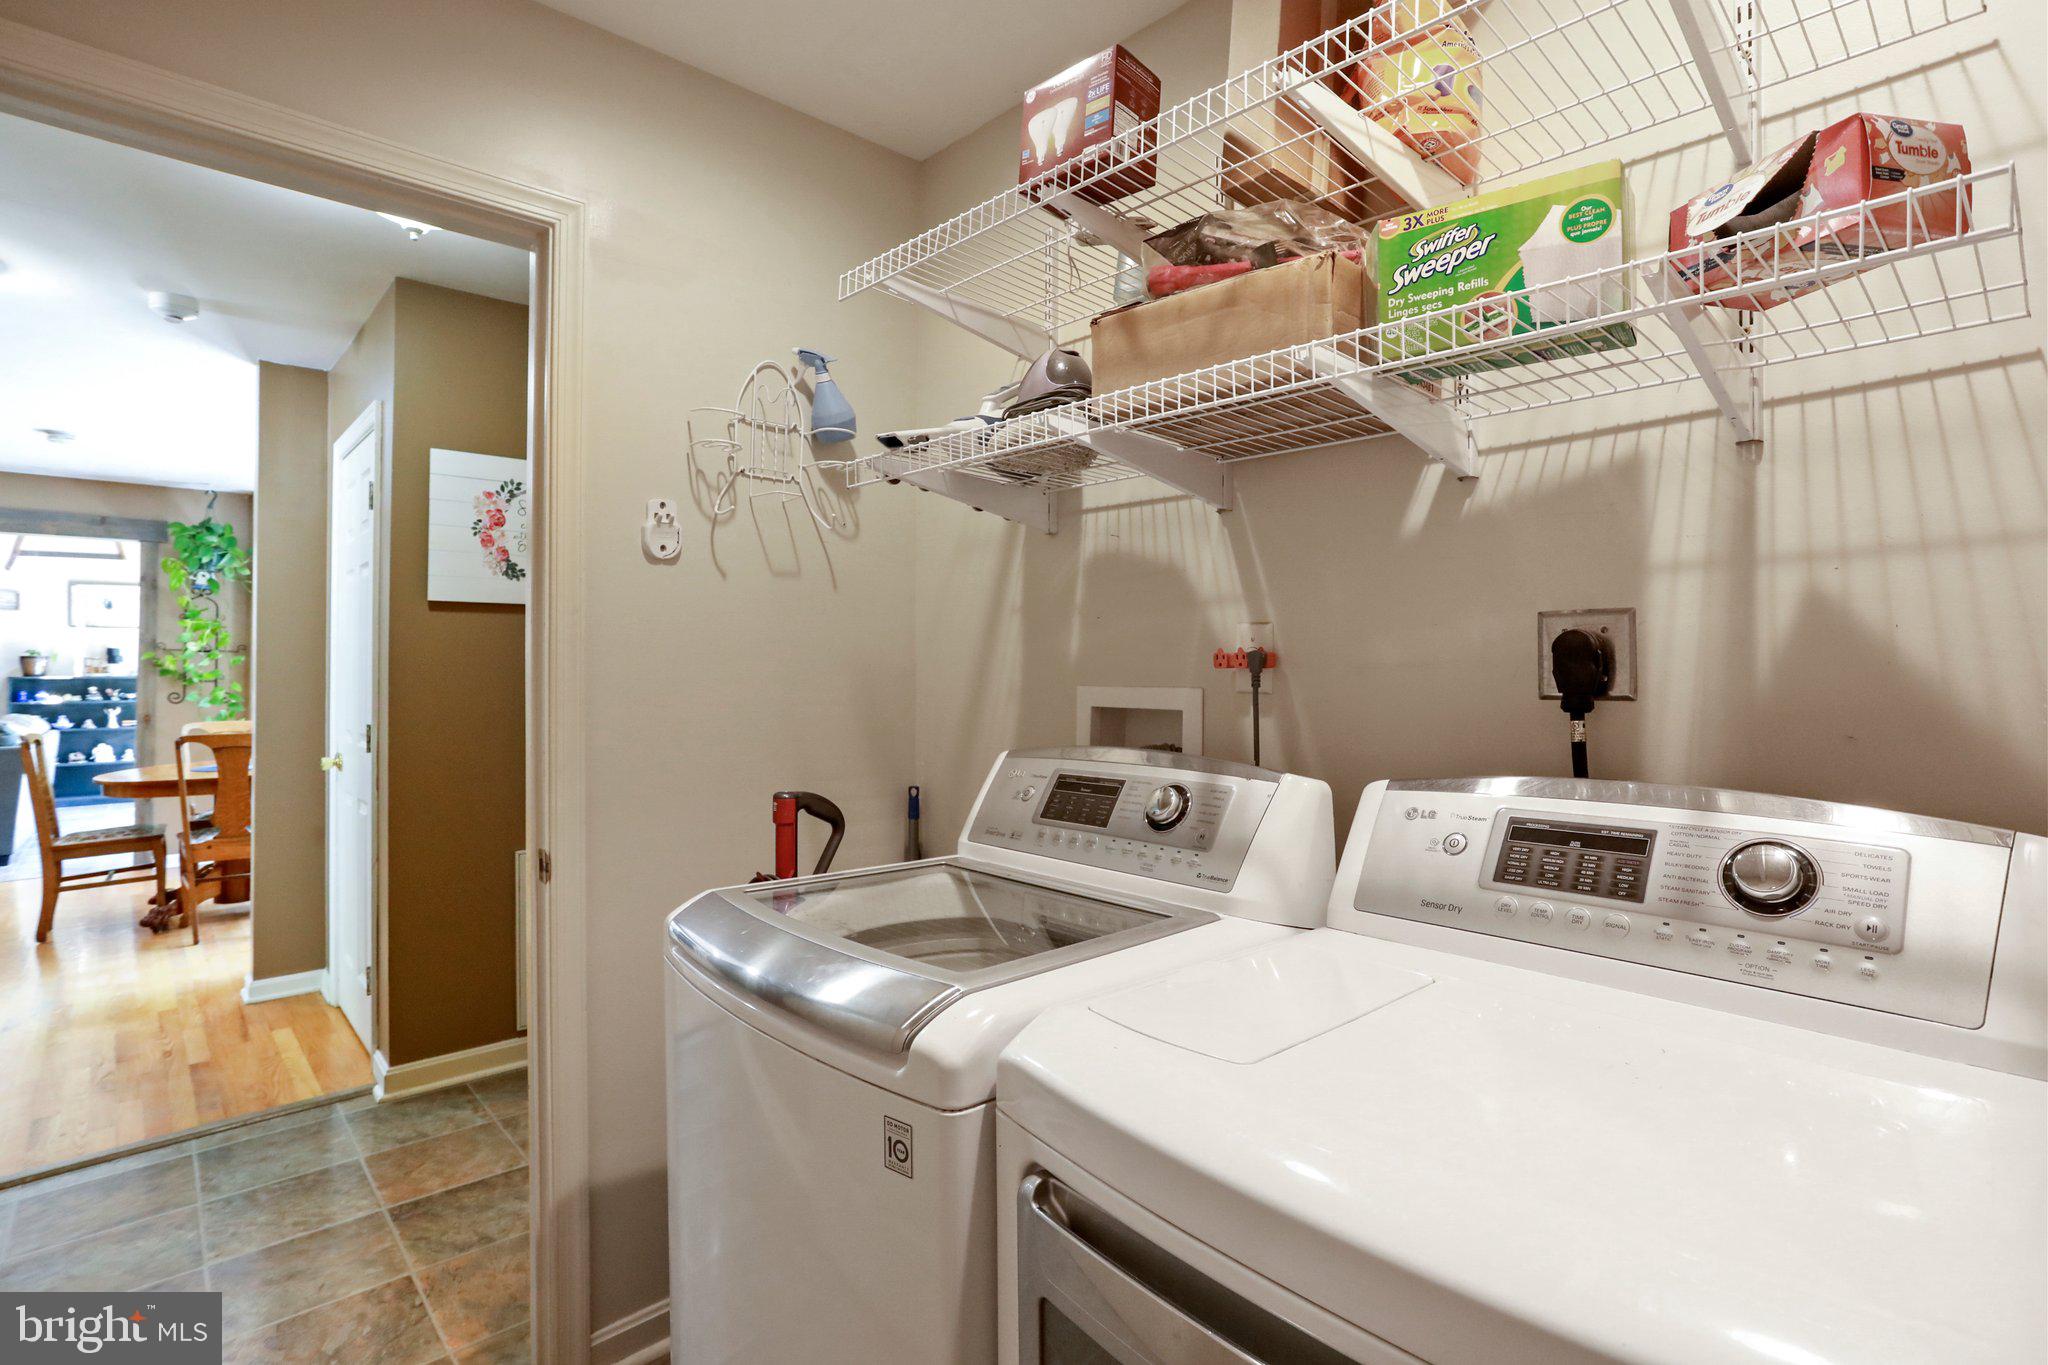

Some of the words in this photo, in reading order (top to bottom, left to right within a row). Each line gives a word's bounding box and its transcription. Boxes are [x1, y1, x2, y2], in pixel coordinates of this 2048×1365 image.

[1096, 83, 1110, 95] LIFE
[1895, 141, 1939, 159] Tumble
[1427, 207, 1449, 218] MORE
[1569, 211, 1583, 220] BEST
[1403, 214, 1425, 231] 3X
[1426, 216, 1445, 225] PLUS
[1412, 223, 1478, 263] Swiffer
[1387, 233, 1497, 296] Sweeper
[1388, 298, 1405, 308] Dry
[1408, 287, 1454, 303] Sweeping
[1457, 277, 1489, 292] Refills
[1388, 305, 1419, 319] Linges
[1422, 301, 1443, 311] secs
[1854, 852, 1893, 861] DELICATES
[1863, 864, 1892, 872] TOWELS
[1842, 887, 1867, 895] SMALL
[1869, 890, 1890, 898] LOAD
[1420, 899, 1447, 912] Sensor
[1448, 904, 1463, 915] Dry
[1848, 900, 1871, 908] SPEED
[1605, 921, 1627, 931] SIGNAL
[1745, 963, 1770, 972] OPTION
[887, 1136, 909, 1164] 10
